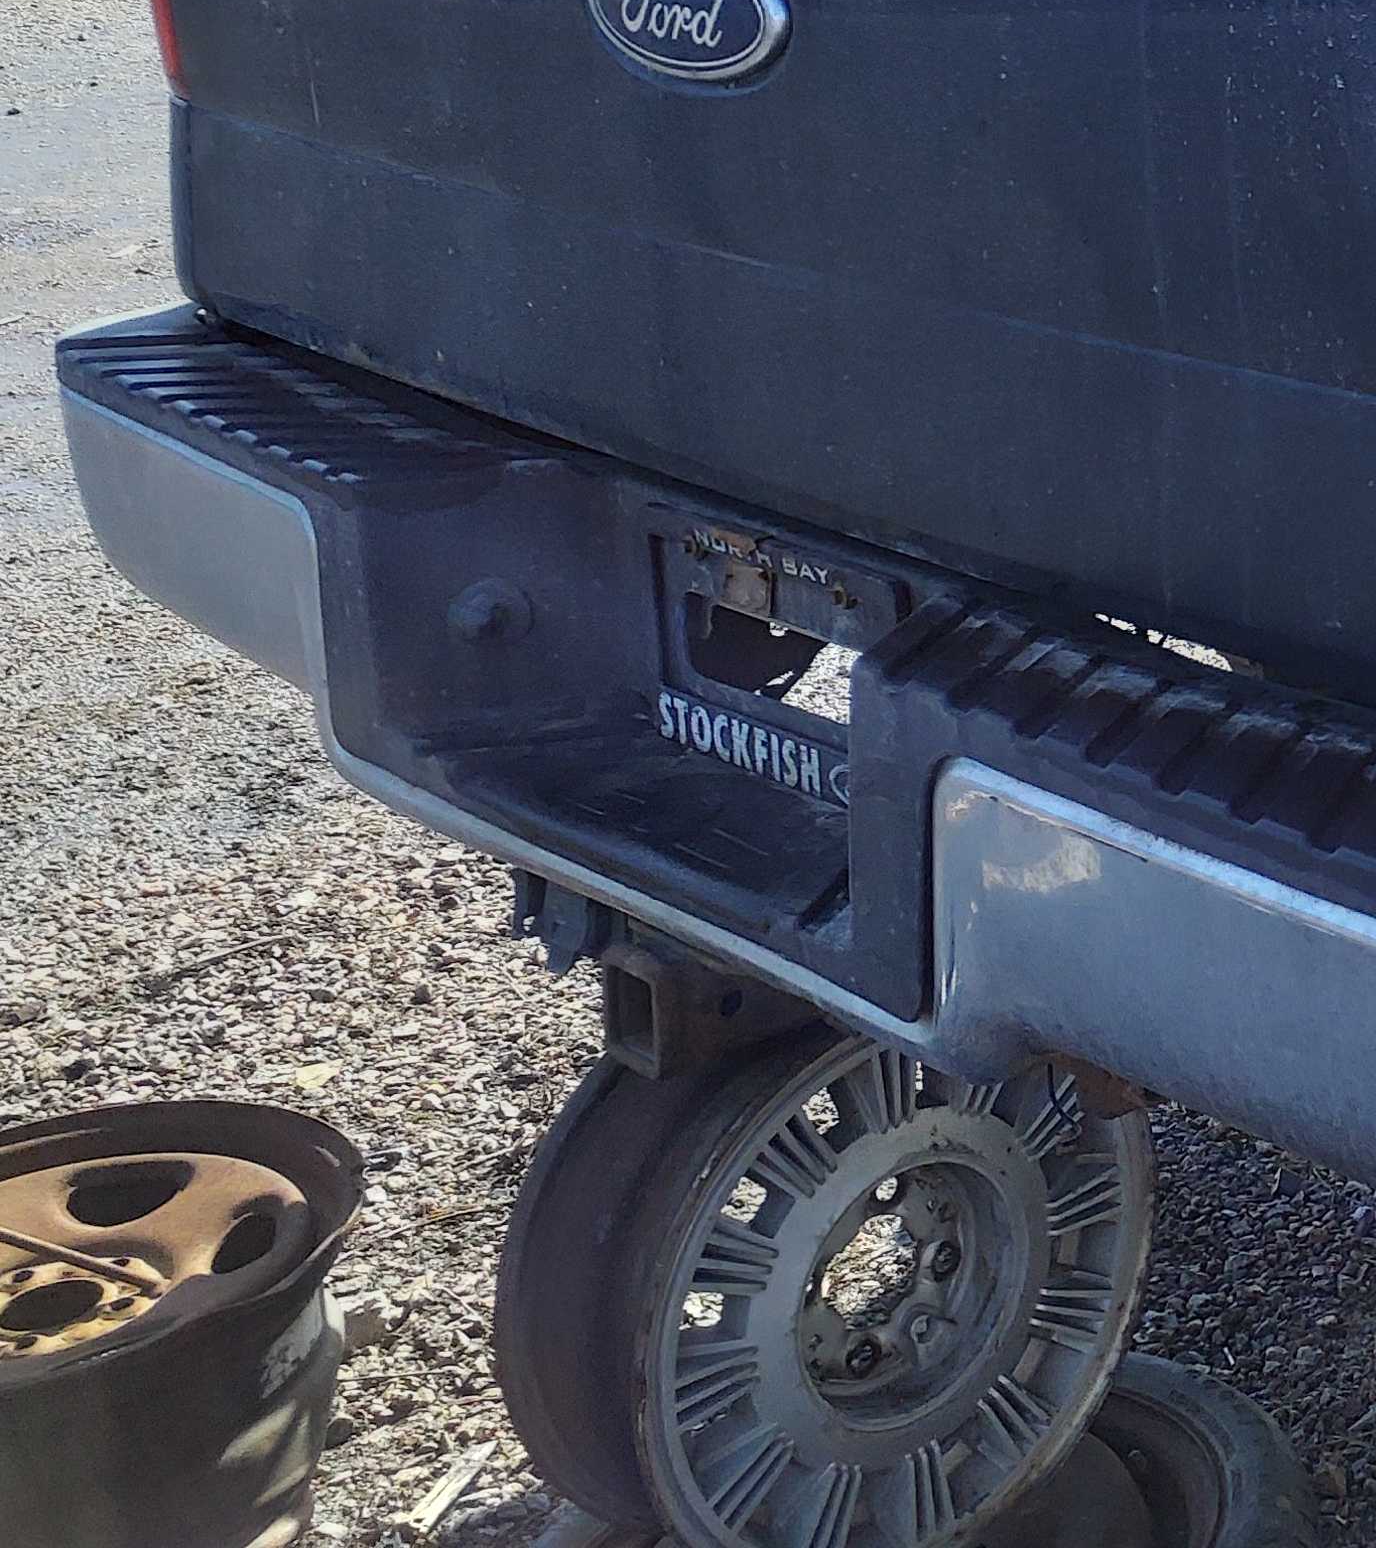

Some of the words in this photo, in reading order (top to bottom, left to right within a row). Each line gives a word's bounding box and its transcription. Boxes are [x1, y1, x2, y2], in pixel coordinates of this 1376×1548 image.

[693, 528, 773, 568] NORH
[782, 555, 829, 585] BAY
[657, 690, 822, 798] STOCKFISH
